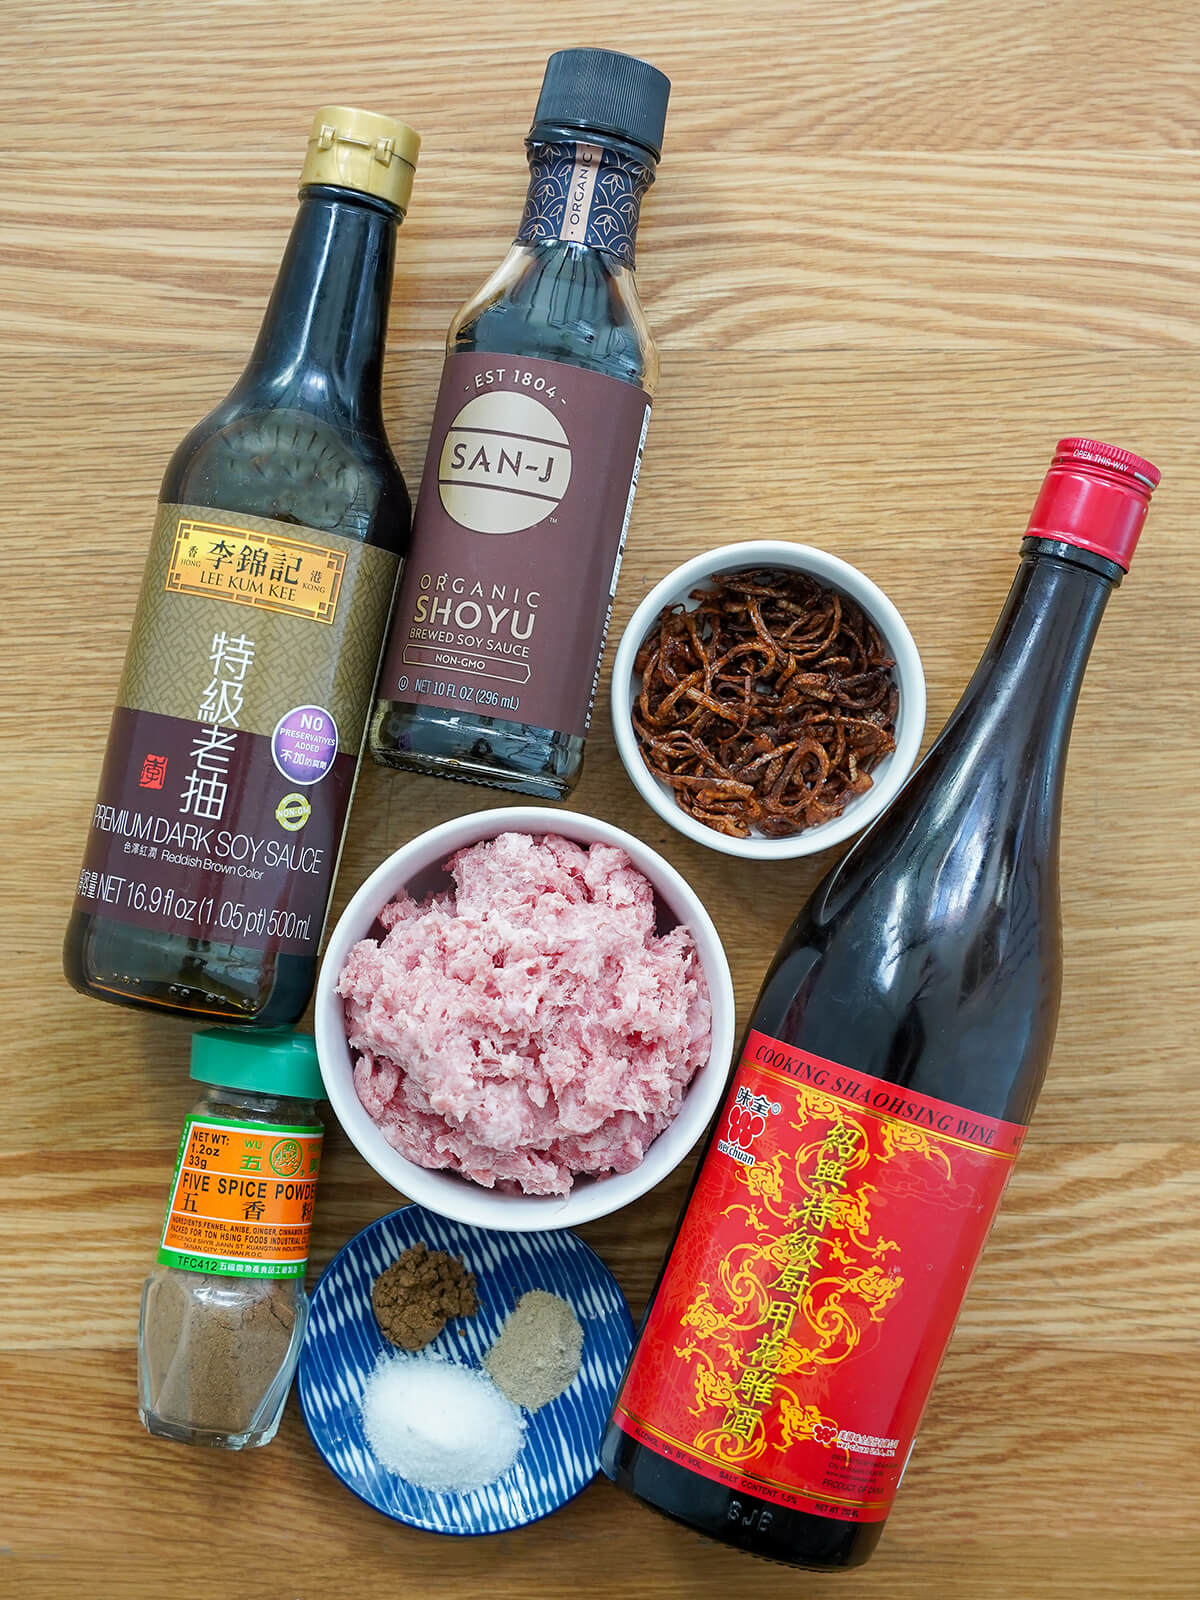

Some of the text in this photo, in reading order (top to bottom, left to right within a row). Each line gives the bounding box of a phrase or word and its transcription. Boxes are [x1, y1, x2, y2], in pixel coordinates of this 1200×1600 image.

[569, 152, 593, 225] ORGANIC
[474, 369, 557, 399] EST 1804
[451, 443, 554, 484] SAN-J
[1072, 448, 1093, 460] OPEN
[1094, 454, 1111, 467] THIS
[180, 559, 201, 568] HONG
[188, 545, 198, 558] 香
[206, 539, 303, 585] 李錦記
[200, 571, 297, 602] LEE KUM KEE
[303, 583, 326, 594] KONG
[310, 570, 323, 584] 港
[420, 573, 541, 608] ORGANIC
[413, 594, 536, 641] SHOYU
[409, 627, 530, 658] BREWED SOY SAUCE
[435, 653, 486, 671] NON-GMO
[414, 678, 520, 712] NET 10 FL OZ (296 mL)
[179, 631, 256, 821] 特級老抽
[280, 727, 336, 746] PRESERVATIVES
[300, 713, 324, 732] NO
[295, 741, 320, 753] ADDED
[92, 803, 325, 874] PREMIUM DARK SOY SAUCE
[160, 850, 203, 869] Reddish
[203, 858, 237, 876] Brown
[237, 865, 264, 881] Color
[97, 873, 127, 904] NET
[127, 882, 162, 913] 16.9
[163, 889, 175, 916] fl
[174, 897, 198, 922] oz
[198, 896, 245, 929] (1.05
[243, 907, 267, 937] pt)
[267, 910, 312, 941] 500mL
[736, 1087, 772, 1117] 味全
[755, 1044, 997, 1147] COOKING SHAOHSING WINE
[190, 1144, 220, 1157] 1.2oz
[192, 1130, 230, 1147] NET WT:
[244, 1139, 264, 1151] WU
[188, 1155, 208, 1169] 33g
[240, 1155, 263, 1172] 五
[182, 1172, 317, 1201] FIVE SPICE POWDE
[190, 1227, 202, 1237] FOR
[204, 1230, 217, 1240] TON
[220, 1233, 242, 1243] HSING
[245, 1236, 268, 1245] FOODS
[178, 1256, 218, 1272] TFC412
[719, 1470, 739, 1484] SALT
[741, 1480, 778, 1499] CONTENT
